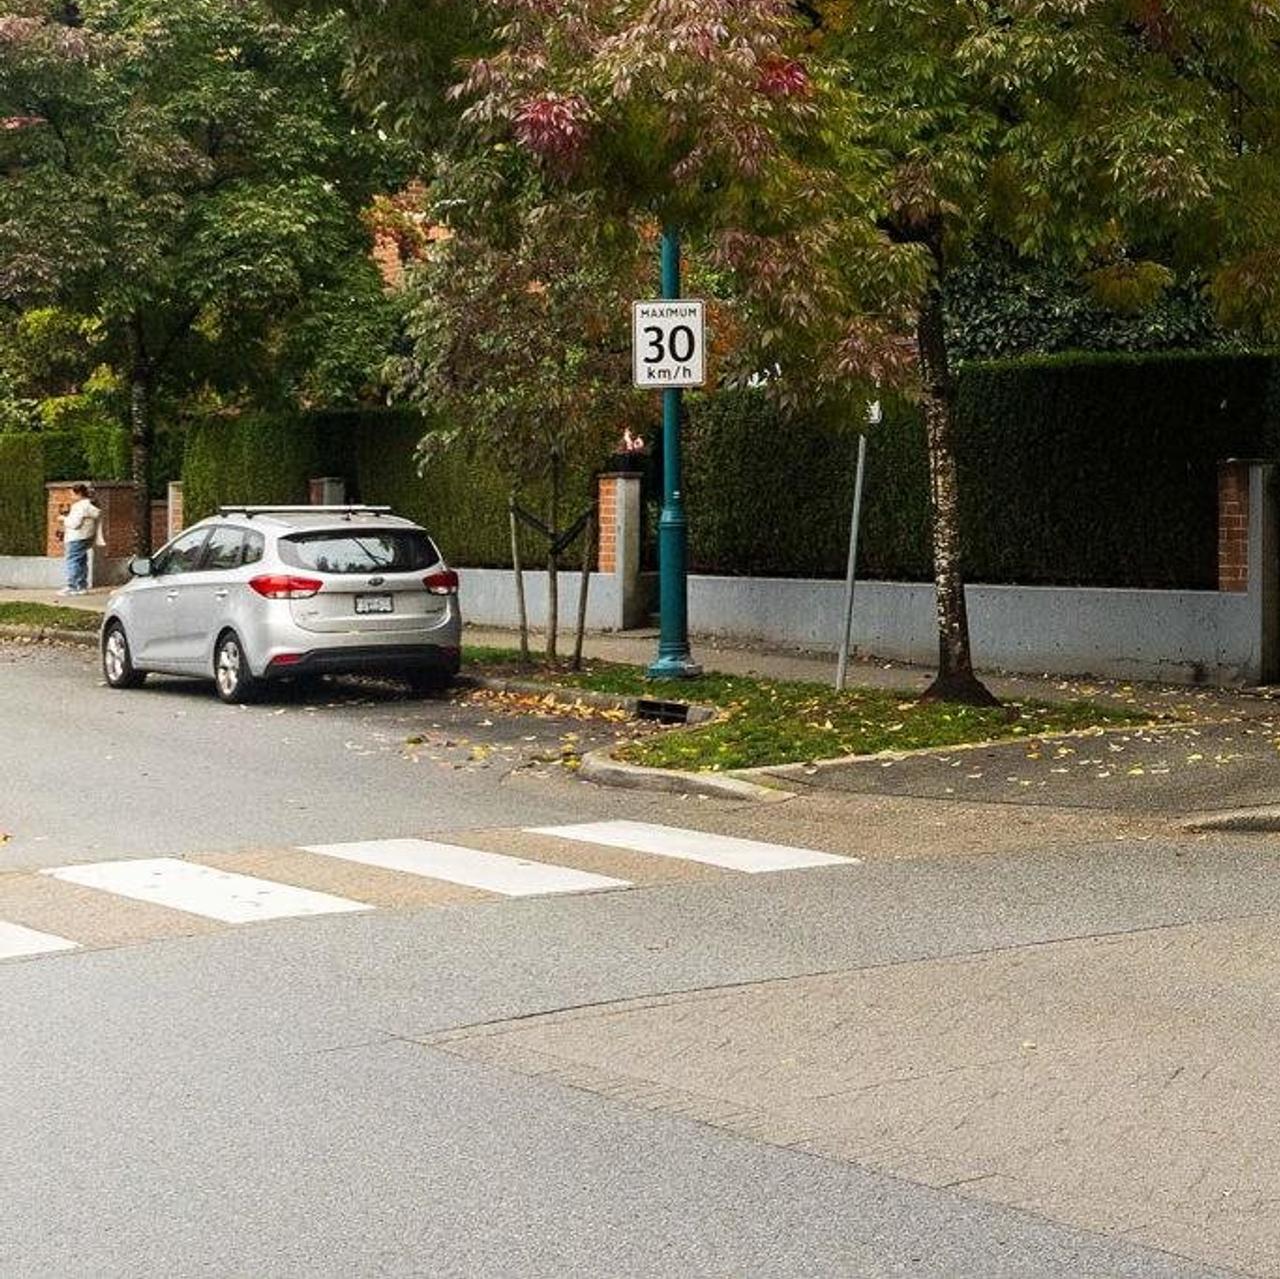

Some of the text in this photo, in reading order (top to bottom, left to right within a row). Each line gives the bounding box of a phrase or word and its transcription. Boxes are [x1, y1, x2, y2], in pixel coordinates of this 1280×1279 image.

[640, 308, 697, 318] MAXIMUM
[643, 325, 695, 363] 30
[647, 366, 692, 379] km/h
